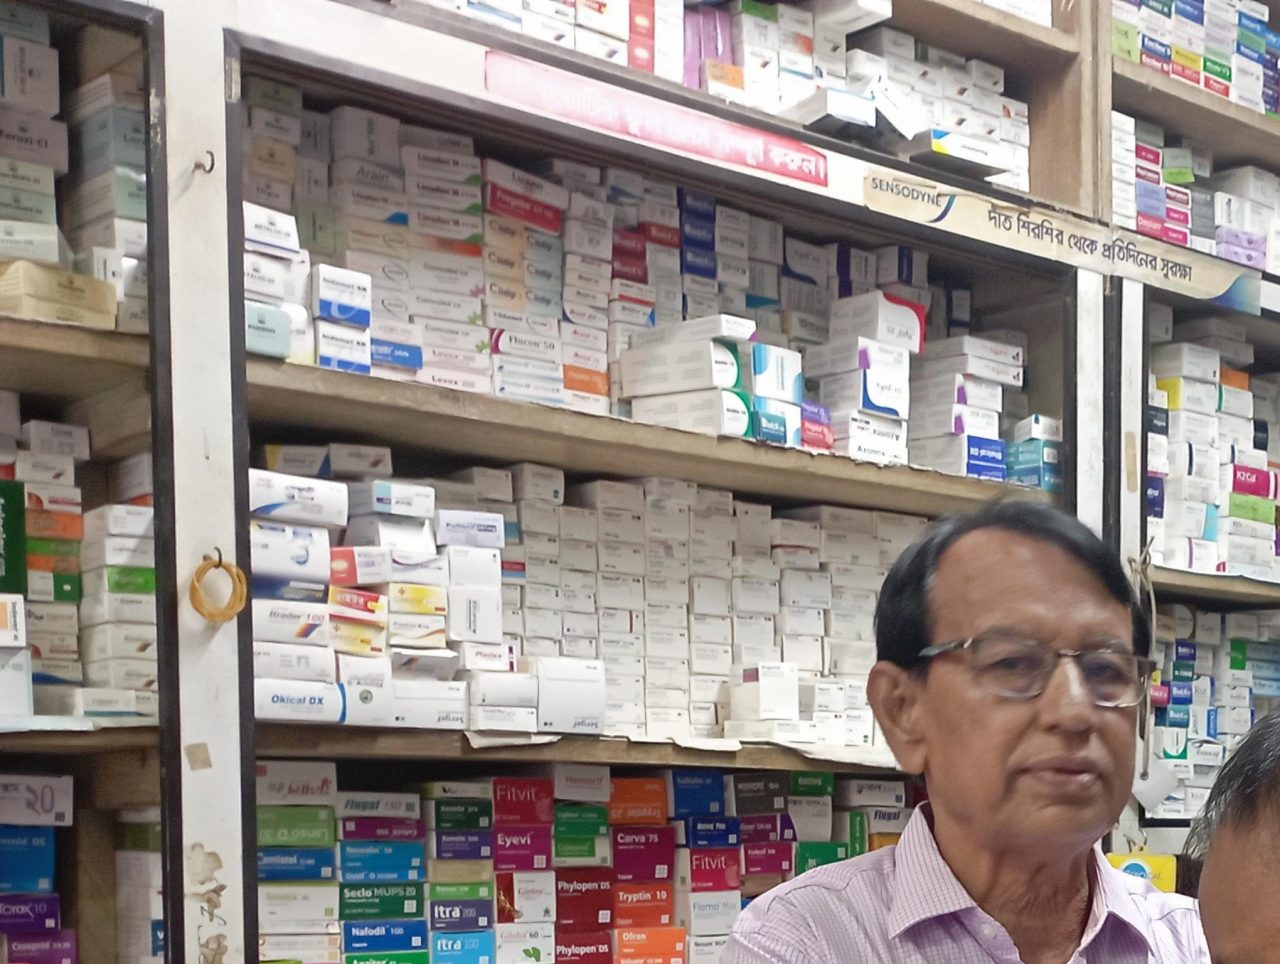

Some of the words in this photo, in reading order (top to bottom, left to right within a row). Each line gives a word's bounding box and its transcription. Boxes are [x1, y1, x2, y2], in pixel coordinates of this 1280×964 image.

[872, 177, 943, 207] SENSODYNE
[988, 204, 1013, 232] দাঁত
[1016, 210, 1064, 246] শিরশির
[1068, 234, 1099, 256] থেকে
[1101, 238, 1158, 272] প্রতিদিনের
[1160, 257, 1193, 282] সুরক্ষা
[271, 693, 306, 706] Okical
[308, 694, 324, 706] DX
[495, 784, 537, 802] Fitvit
[344, 800, 381, 812] Flugal
[497, 832, 532, 847] Eyevi
[617, 833, 646, 843] Carva
[648, 833, 659, 843] 75
[692, 854, 727, 870] Fitvit
[344, 887, 373, 899] Seclo
[373, 886, 405, 897] MUPS
[405, 886, 416, 896] 20
[558, 880, 599, 892] Phylopen
[600, 881, 611, 890] DS
[618, 890, 651, 903] Tryptin
[656, 890, 667, 900] 10
[434, 904, 461, 919] Itra
[463, 908, 476, 918] 200
[352, 926, 386, 937] Nafodil
[390, 926, 405, 936] 100
[529, 931, 539, 939] 60
[622, 932, 647, 942] Ofran
[437, 938, 463, 951] Itra
[464, 938, 479, 949] 100
[556, 945, 597, 956] Phylopen
[598, 944, 609, 953] DS
